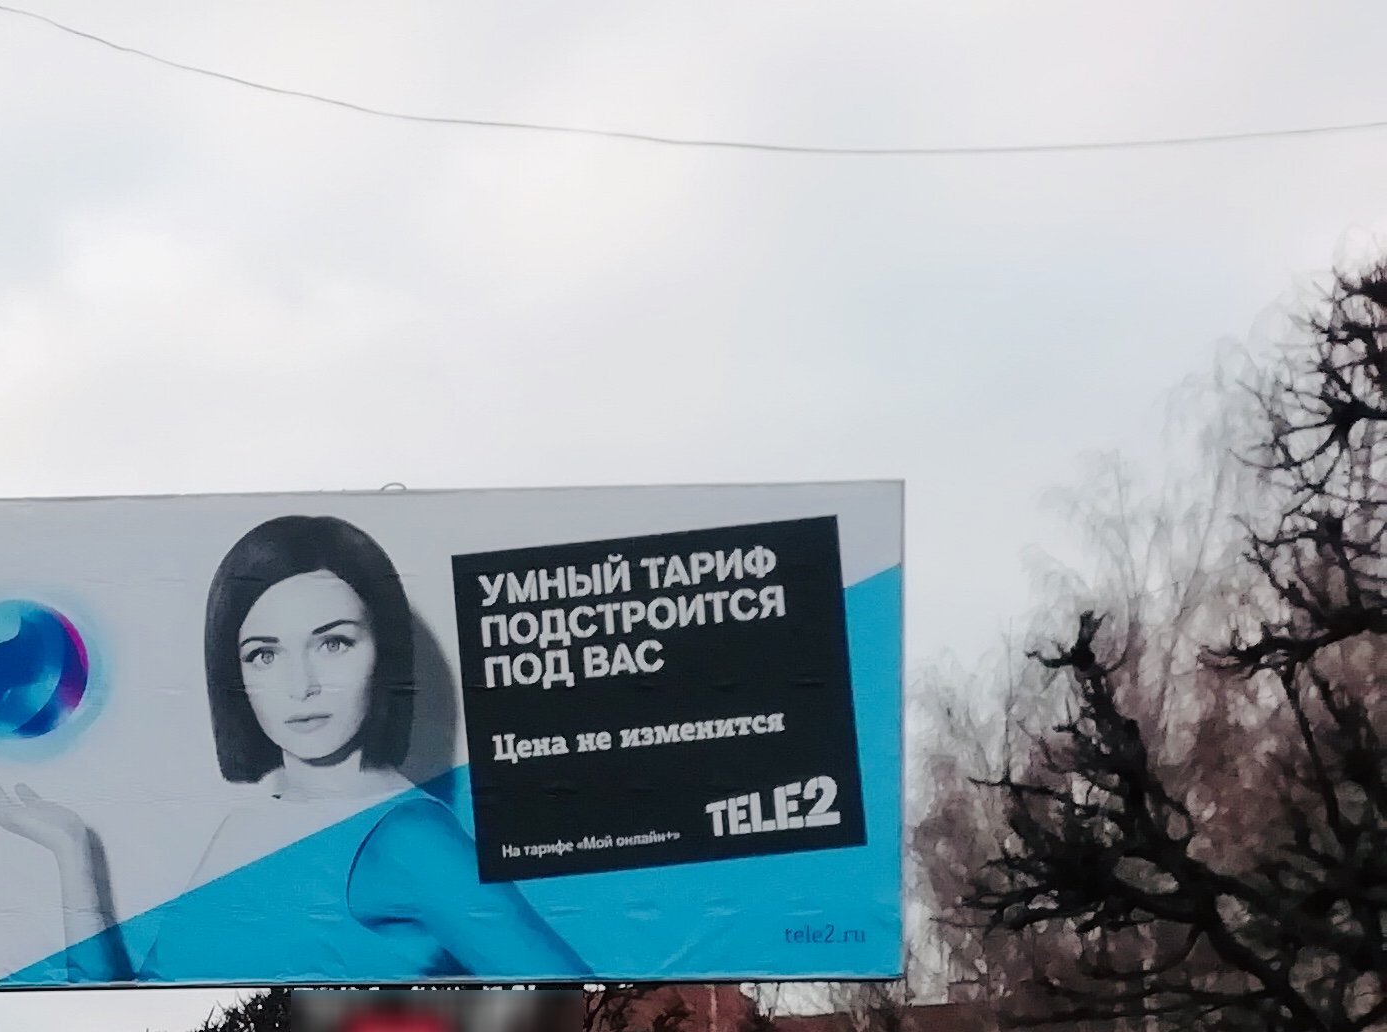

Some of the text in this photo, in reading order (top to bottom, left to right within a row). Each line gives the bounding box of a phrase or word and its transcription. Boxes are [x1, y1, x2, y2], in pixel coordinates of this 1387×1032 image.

[478, 545, 777, 606] УМНЫЙ ТАРИФ
[481, 585, 786, 648] ПОДСТРОИТСЯ
[484, 639, 665, 690] ПОД ВАС
[491, 712, 785, 764] Цена не изменится
[705, 775, 841, 837] TELE2
[501, 844, 521, 858] На
[524, 839, 573, 858] тарифе
[784, 924, 866, 944] tele2.ru
